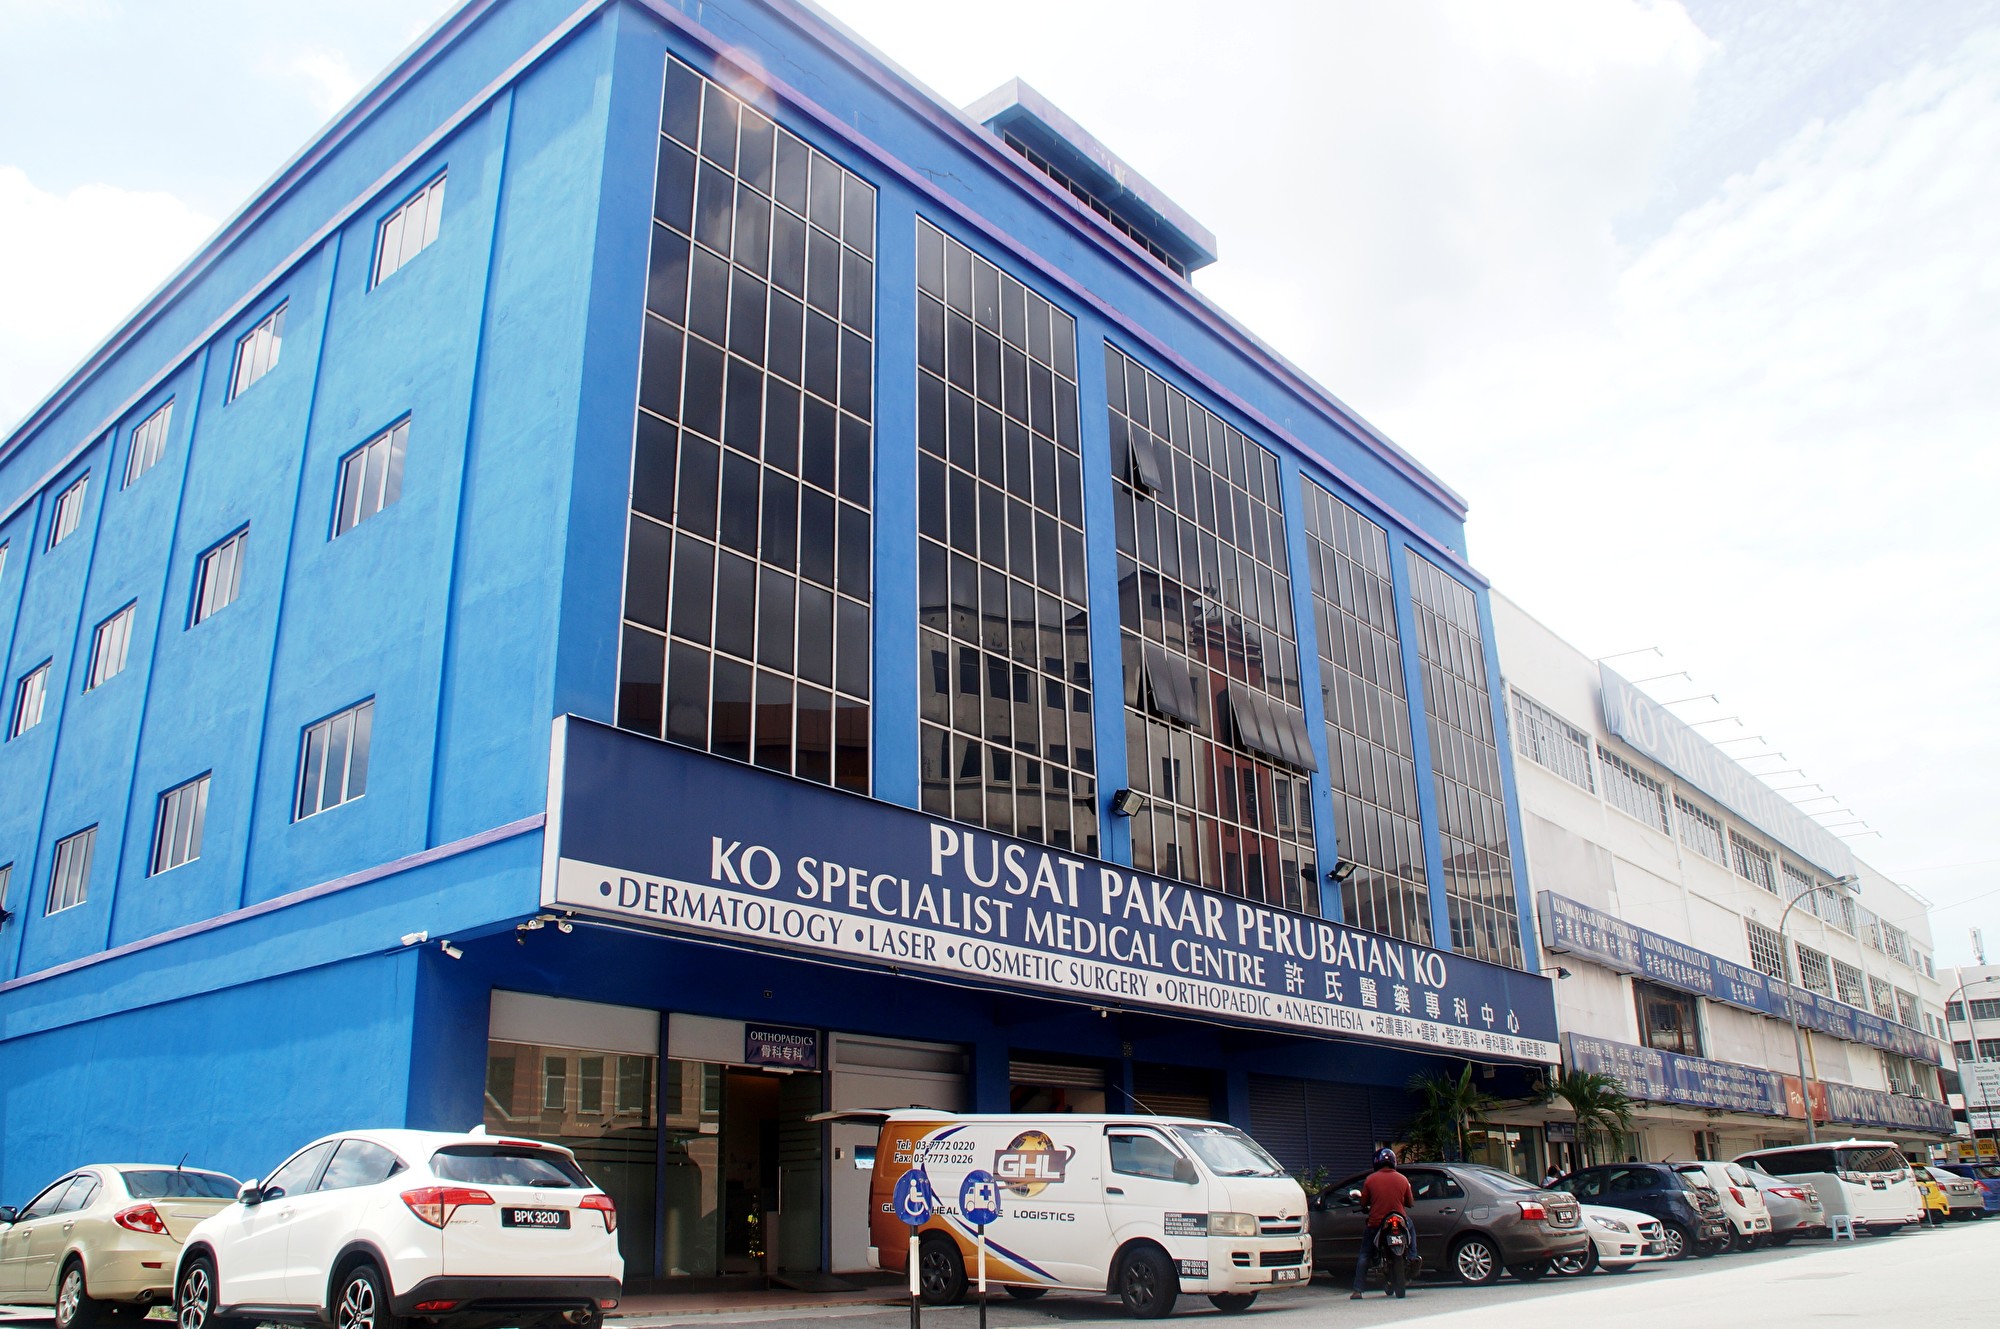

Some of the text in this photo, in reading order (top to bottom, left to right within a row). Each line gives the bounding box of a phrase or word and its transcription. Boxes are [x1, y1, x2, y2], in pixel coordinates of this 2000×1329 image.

[1618, 684, 1658, 751] KO
[1661, 715, 1714, 785] SKIN
[711, 836, 1266, 987] KO SPECIALIST MEDICAL CENTRE
[930, 823, 1446, 989] PUSAT PAKAR PERUBATAN KO
[1552, 896, 1638, 943] KLINIK PAKAR ORTOPEDIK KO
[618, 877, 1364, 1033] DERMATOLOGY LASER COSMETIC SURGERY ORTHOPAEDIC ANAESTHESIA
[1641, 931, 1664, 954] KLINIK
[1664, 939, 1683, 961] PAKAR
[1683, 947, 1699, 967] KULIT
[1715, 958, 1762, 989] PLASTIC SURGERY
[1284, 961, 1519, 1034] 許氏醫藥專科中心
[750, 1031, 813, 1046] ORTHOPAEDICS
[761, 1044, 803, 1061] 骨科专科
[894, 1153, 973, 1164] Fax: 03-7773 0226
[897, 1140, 975, 1151] Tel: 03-7772 0220
[998, 1154, 1060, 1178] GHL
[514, 1210, 559, 1224] BPK 3200
[1013, 1210, 1075, 1222] LOGISTICS
